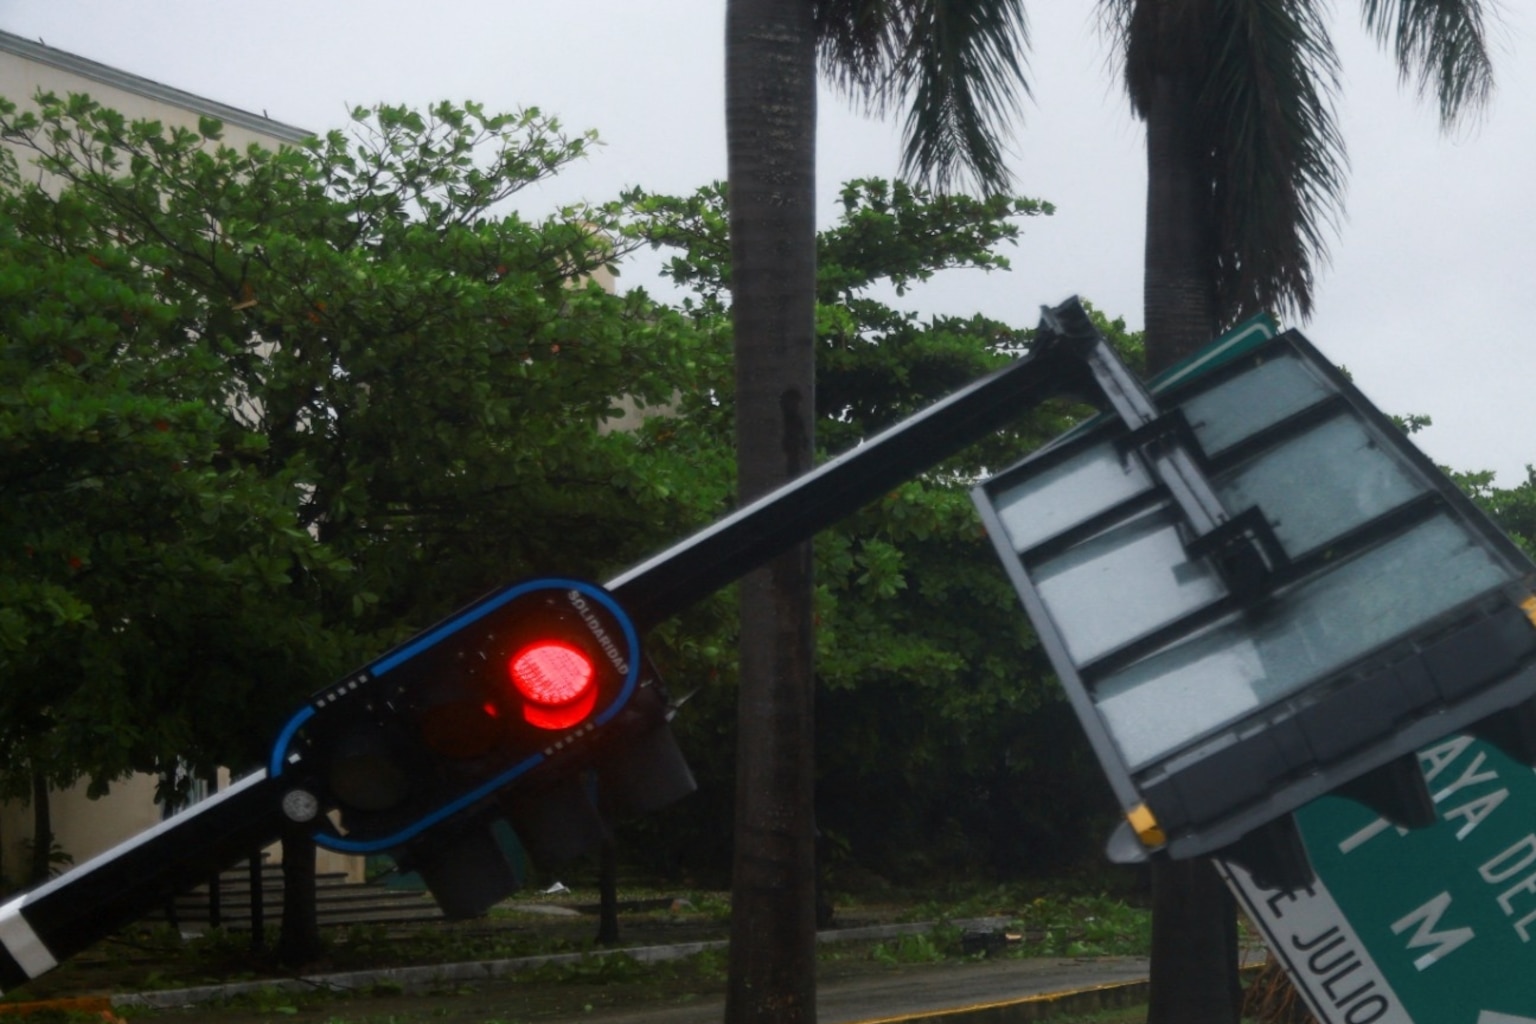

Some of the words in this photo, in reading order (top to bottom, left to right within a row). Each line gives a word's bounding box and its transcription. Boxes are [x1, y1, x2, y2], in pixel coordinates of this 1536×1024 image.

[568, 590, 629, 675] SOLIDARIDAD
[1416, 735, 1510, 841] AYA
[1390, 891, 1475, 972] M
